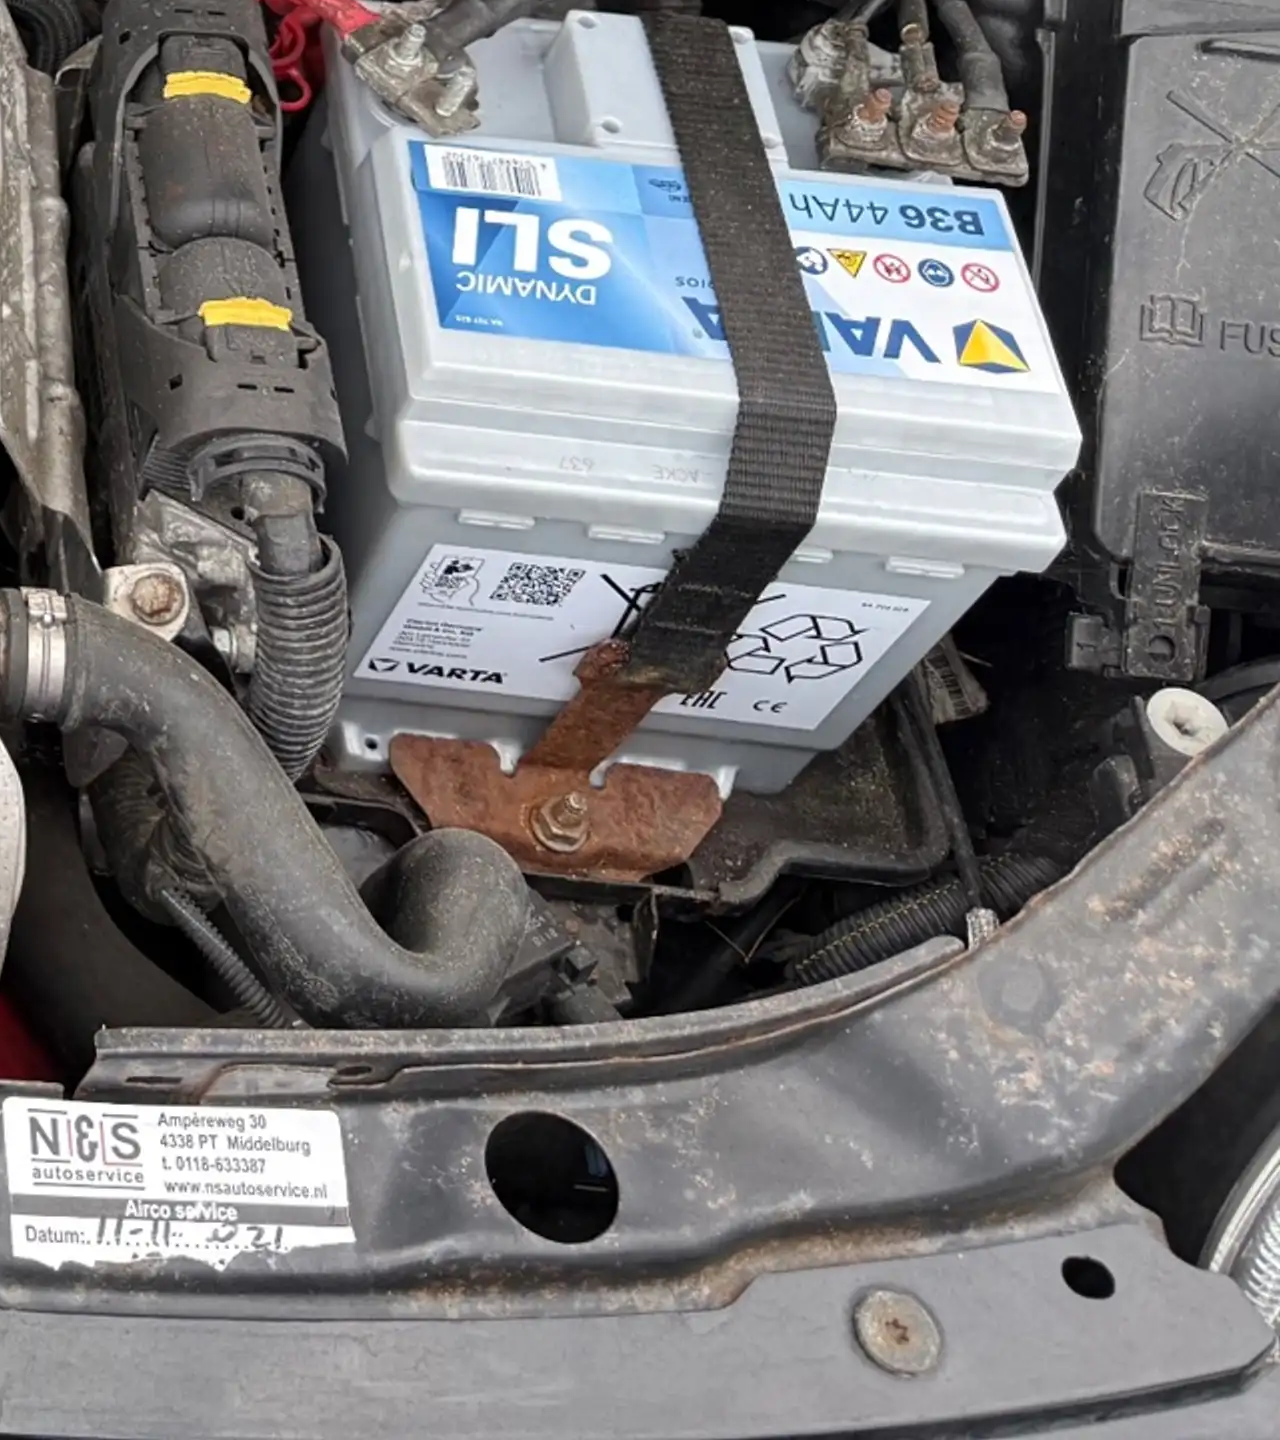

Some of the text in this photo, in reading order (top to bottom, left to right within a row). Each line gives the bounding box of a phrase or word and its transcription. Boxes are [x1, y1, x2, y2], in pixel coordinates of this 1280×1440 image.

[788, 192, 986, 237] B36 44Ah
[451, 205, 614, 281] SLI
[455, 269, 597, 306] DYNAMIC
[688, 296, 942, 365] VAA
[405, 661, 505, 685] VARTA
[248, 1114, 268, 1130] 30
[29, 1113, 142, 1163] N&S
[159, 1133, 312, 1157] 4338 PT Middelburg
[31, 1165, 145, 1184] autoservice
[175, 1157, 267, 1175] 0118-633387
[164, 1180, 329, 1200] www.nsautoservice.nl
[124, 1198, 171, 1220] Airco
[25, 1225, 86, 1246] Datum:
